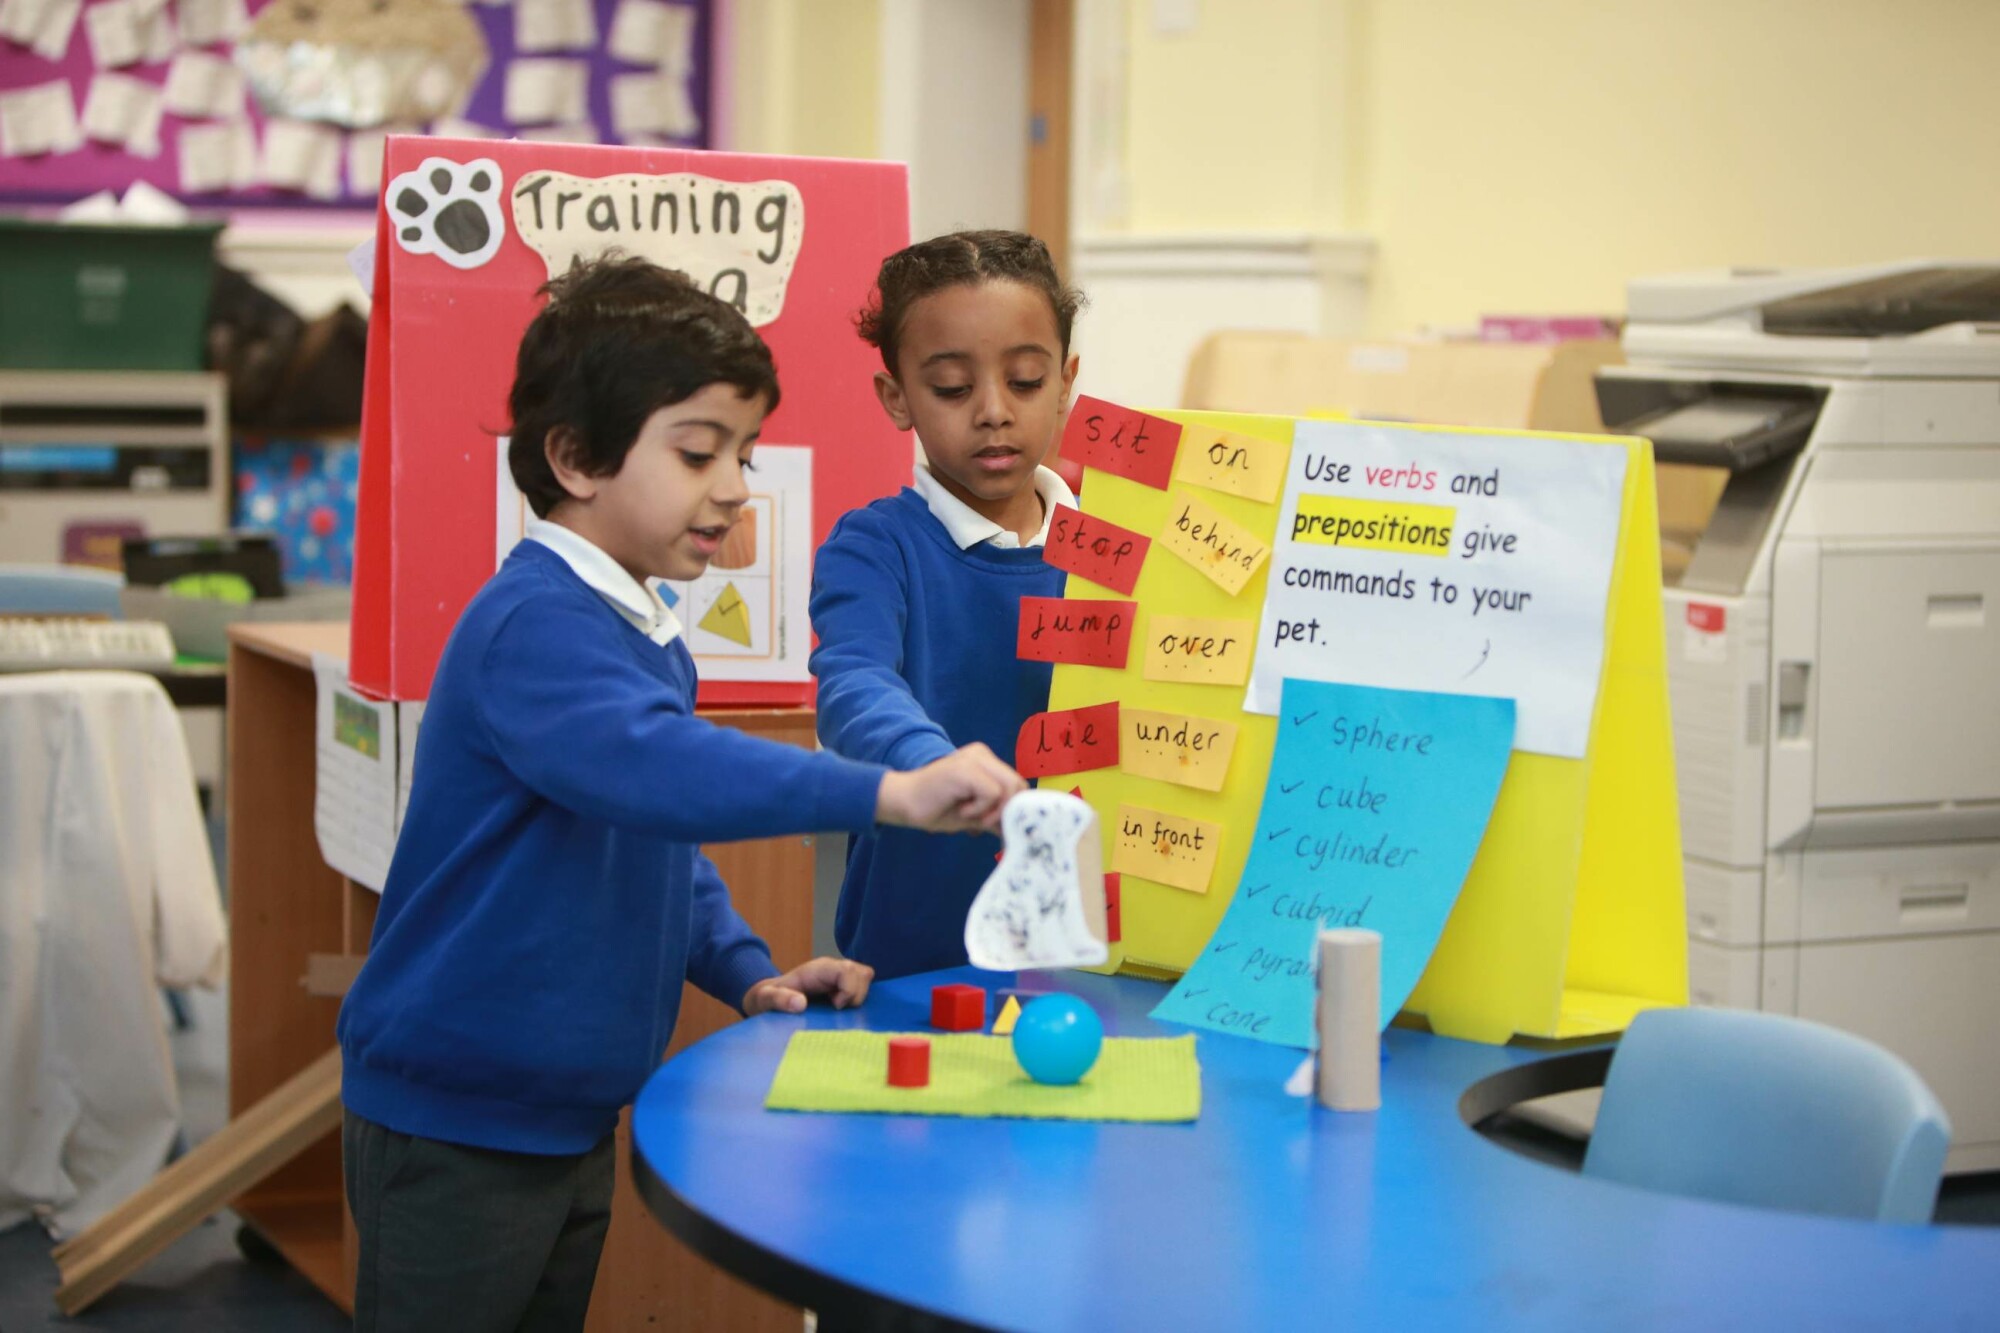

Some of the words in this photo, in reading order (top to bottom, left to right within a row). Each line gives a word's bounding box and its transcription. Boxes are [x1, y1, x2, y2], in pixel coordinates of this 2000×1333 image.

[515, 176, 788, 264] Training
[1086, 415, 1149, 453] sit
[1208, 443, 1249, 470] on
[1304, 454, 1351, 483] Use
[1365, 461, 1437, 491] verbs
[1451, 468, 1499, 496] and
[1057, 520, 1133, 566] stop
[1176, 505, 1264, 570] behind
[1291, 513, 1451, 547] prepositions
[1462, 525, 1518, 558] give
[1284, 566, 1416, 600] commands
[1430, 577, 1458, 603] to
[1472, 587, 1532, 616] your
[1031, 607, 1121, 645] jump
[1275, 618, 1326, 648] pet.
[1159, 635, 1236, 657] over
[1037, 720, 1098, 754] lie
[1137, 721, 1219, 751] under
[1123, 816, 1143, 837] in
[1152, 821, 1204, 850] front
